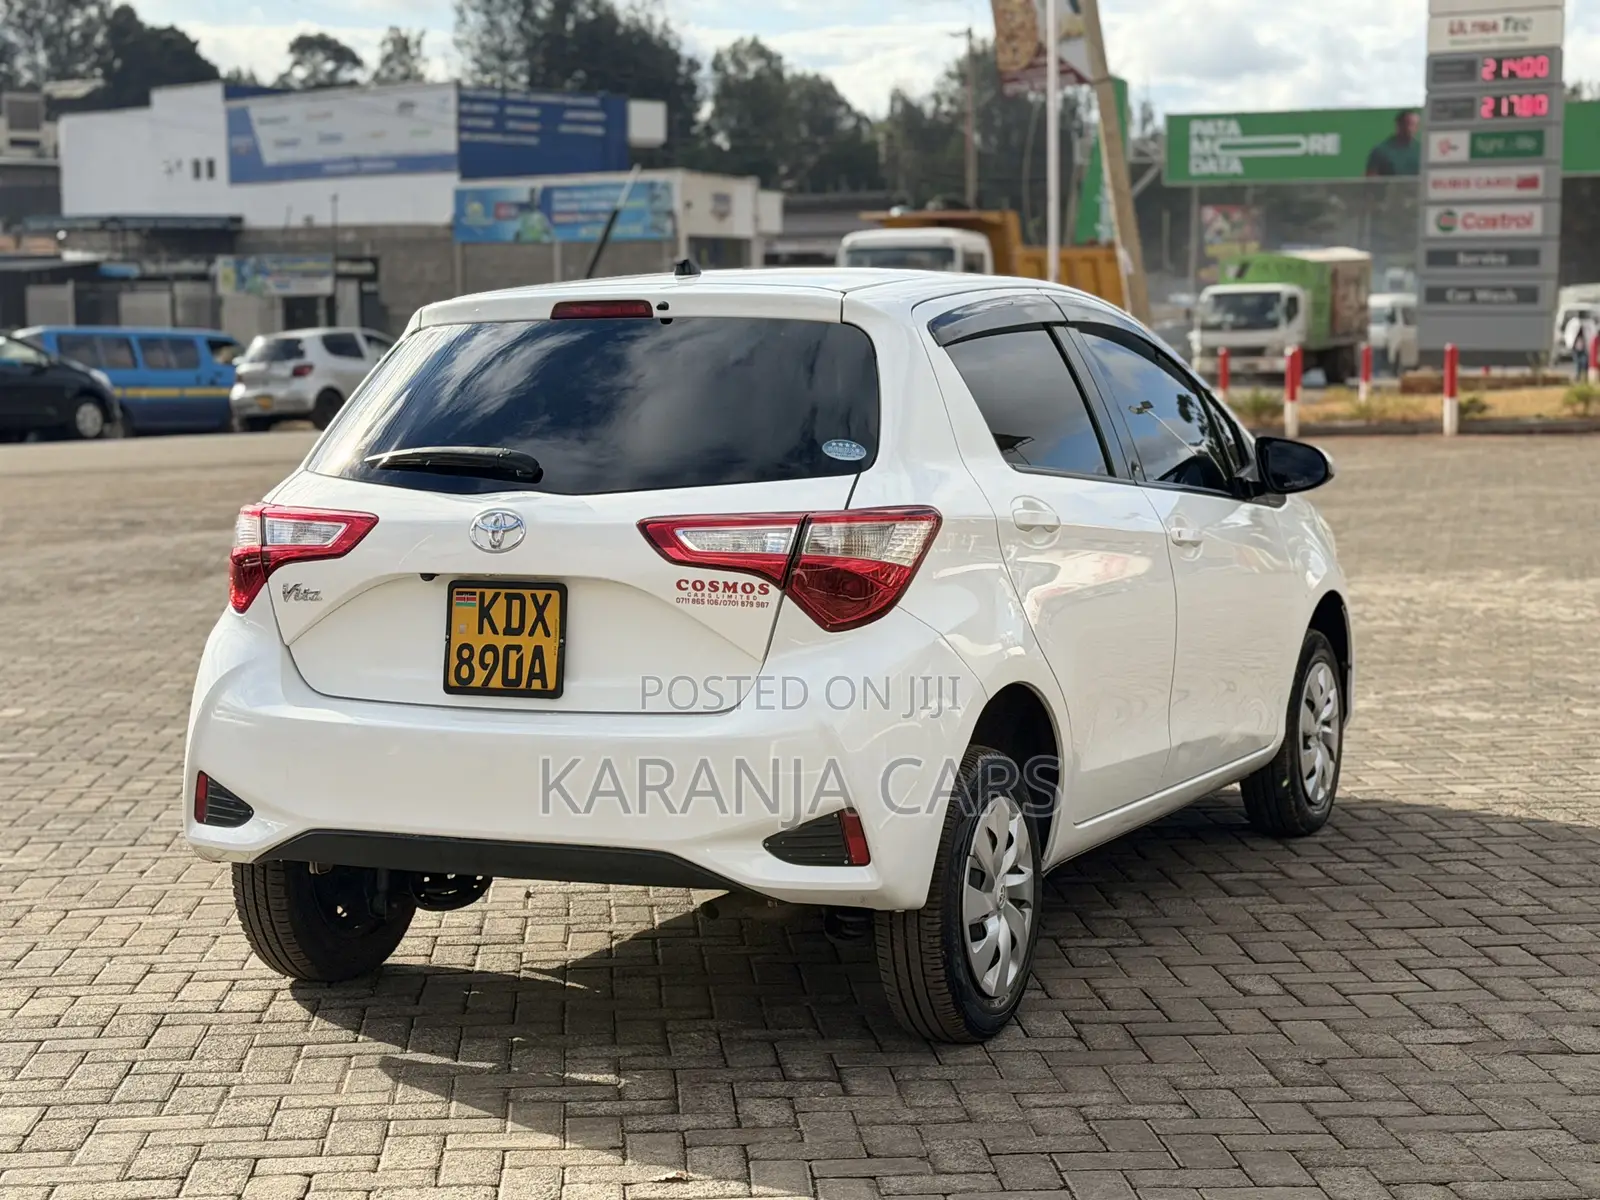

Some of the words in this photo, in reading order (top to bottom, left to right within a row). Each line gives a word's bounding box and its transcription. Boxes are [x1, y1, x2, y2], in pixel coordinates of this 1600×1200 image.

[1189, 119, 1242, 136] PATA
[1189, 156, 1244, 176] DATA
[1461, 212, 1534, 231] Castrol
[676, 579, 770, 595] COSMOS
[477, 591, 552, 638] KDX
[454, 642, 548, 689] 890A
